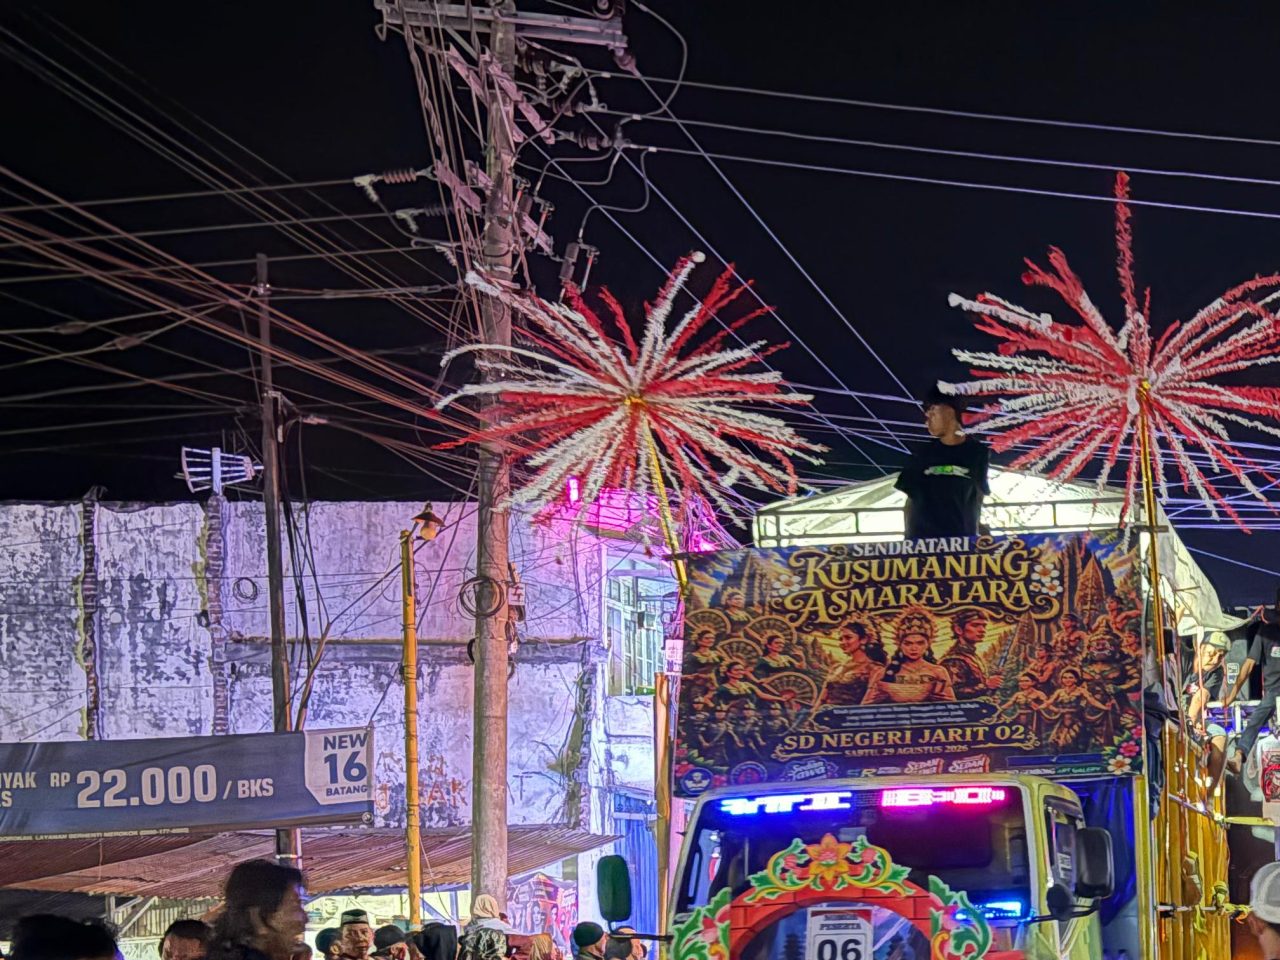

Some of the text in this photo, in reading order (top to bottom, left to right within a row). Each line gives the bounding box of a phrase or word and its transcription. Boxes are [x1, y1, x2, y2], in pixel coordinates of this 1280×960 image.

[852, 537, 970, 556] SENDRATARI
[789, 549, 1036, 589] KUSUMANING
[784, 583, 941, 624] ASMARA
[324, 733, 367, 750] NEW
[784, 725, 1025, 750] SD NEGERI JARIT 02
[899, 746, 942, 755] AGUSTUS
[324, 751, 367, 784] 16
[0, 772, 37, 788] YAK
[50, 772, 70, 787] RP
[76, 764, 217, 808] 22.000
[238, 778, 274, 798] BKS
[326, 786, 368, 796] BATANG
